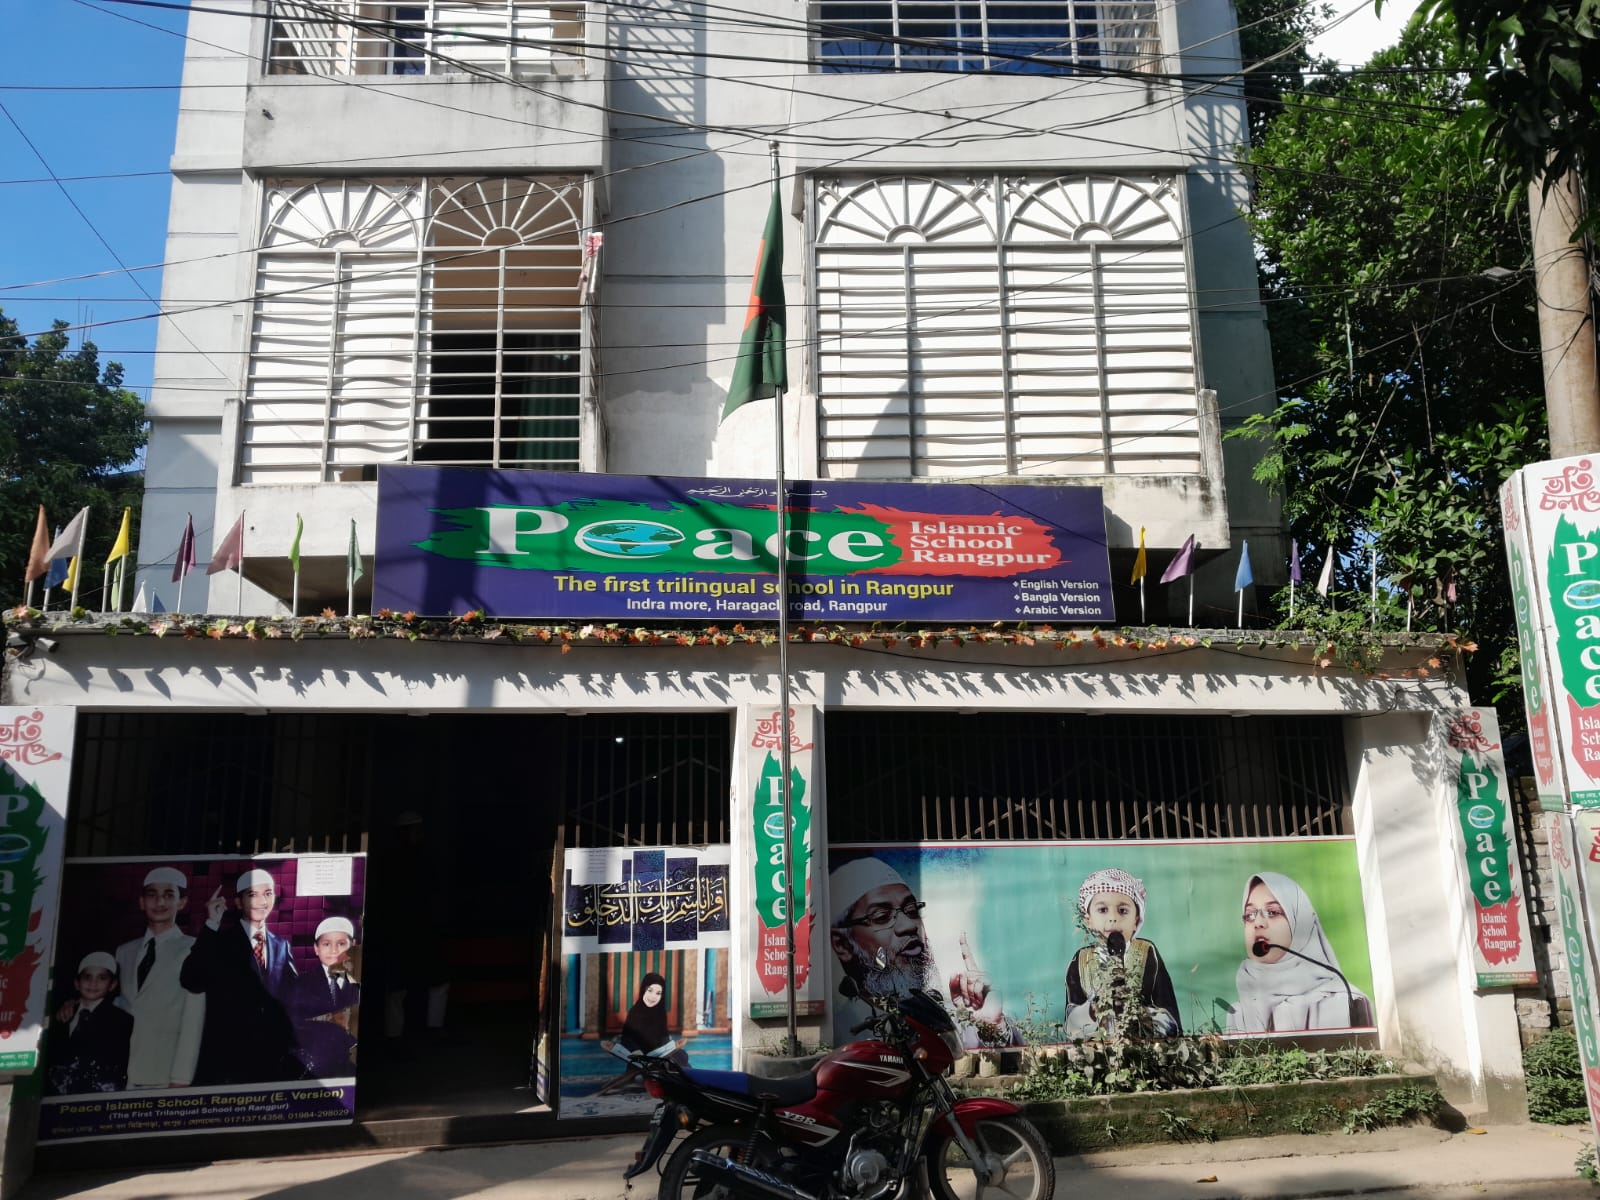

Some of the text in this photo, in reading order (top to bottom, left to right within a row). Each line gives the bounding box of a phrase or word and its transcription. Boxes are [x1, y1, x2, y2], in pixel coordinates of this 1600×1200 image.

[475, 506, 886, 564] Peace
[910, 519, 1023, 536] Islamic
[909, 534, 1015, 550] School
[911, 550, 1053, 567] Rangpur
[553, 575, 598, 593] The
[603, 576, 651, 594] first
[656, 577, 757, 597] trilingual
[840, 579, 860, 596] in
[866, 580, 955, 599] Rangpur
[1020, 578, 1100, 591] English Version
[626, 598, 668, 610] Indra
[669, 600, 713, 613] more,
[789, 600, 826, 613] road,
[829, 600, 888, 613] Rangpur
[1021, 592, 1101, 604] Bangla Version
[1022, 605, 1102, 616] Arabic Version
[1580, 716, 1600, 733] Isla
[1583, 732, 1600, 750] Sch
[0, 740, 63, 766] লছে
[1480, 912, 1508, 925] Islamic
[1482, 924, 1507, 937] School
[764, 934, 787, 947] Islam
[1484, 937, 1517, 951] Rangpur
[764, 948, 786, 961] Scho
[765, 963, 805, 977] Rangr
[60, 1104, 102, 1115] Peace
[105, 1100, 154, 1111] Islamic
[211, 1095, 267, 1106] Rangpur
[291, 1088, 345, 1099] Version)
[132, 1110, 153, 1118] First
[201, 1106, 233, 1114] School
[248, 1103, 289, 1112] Rangpur)
